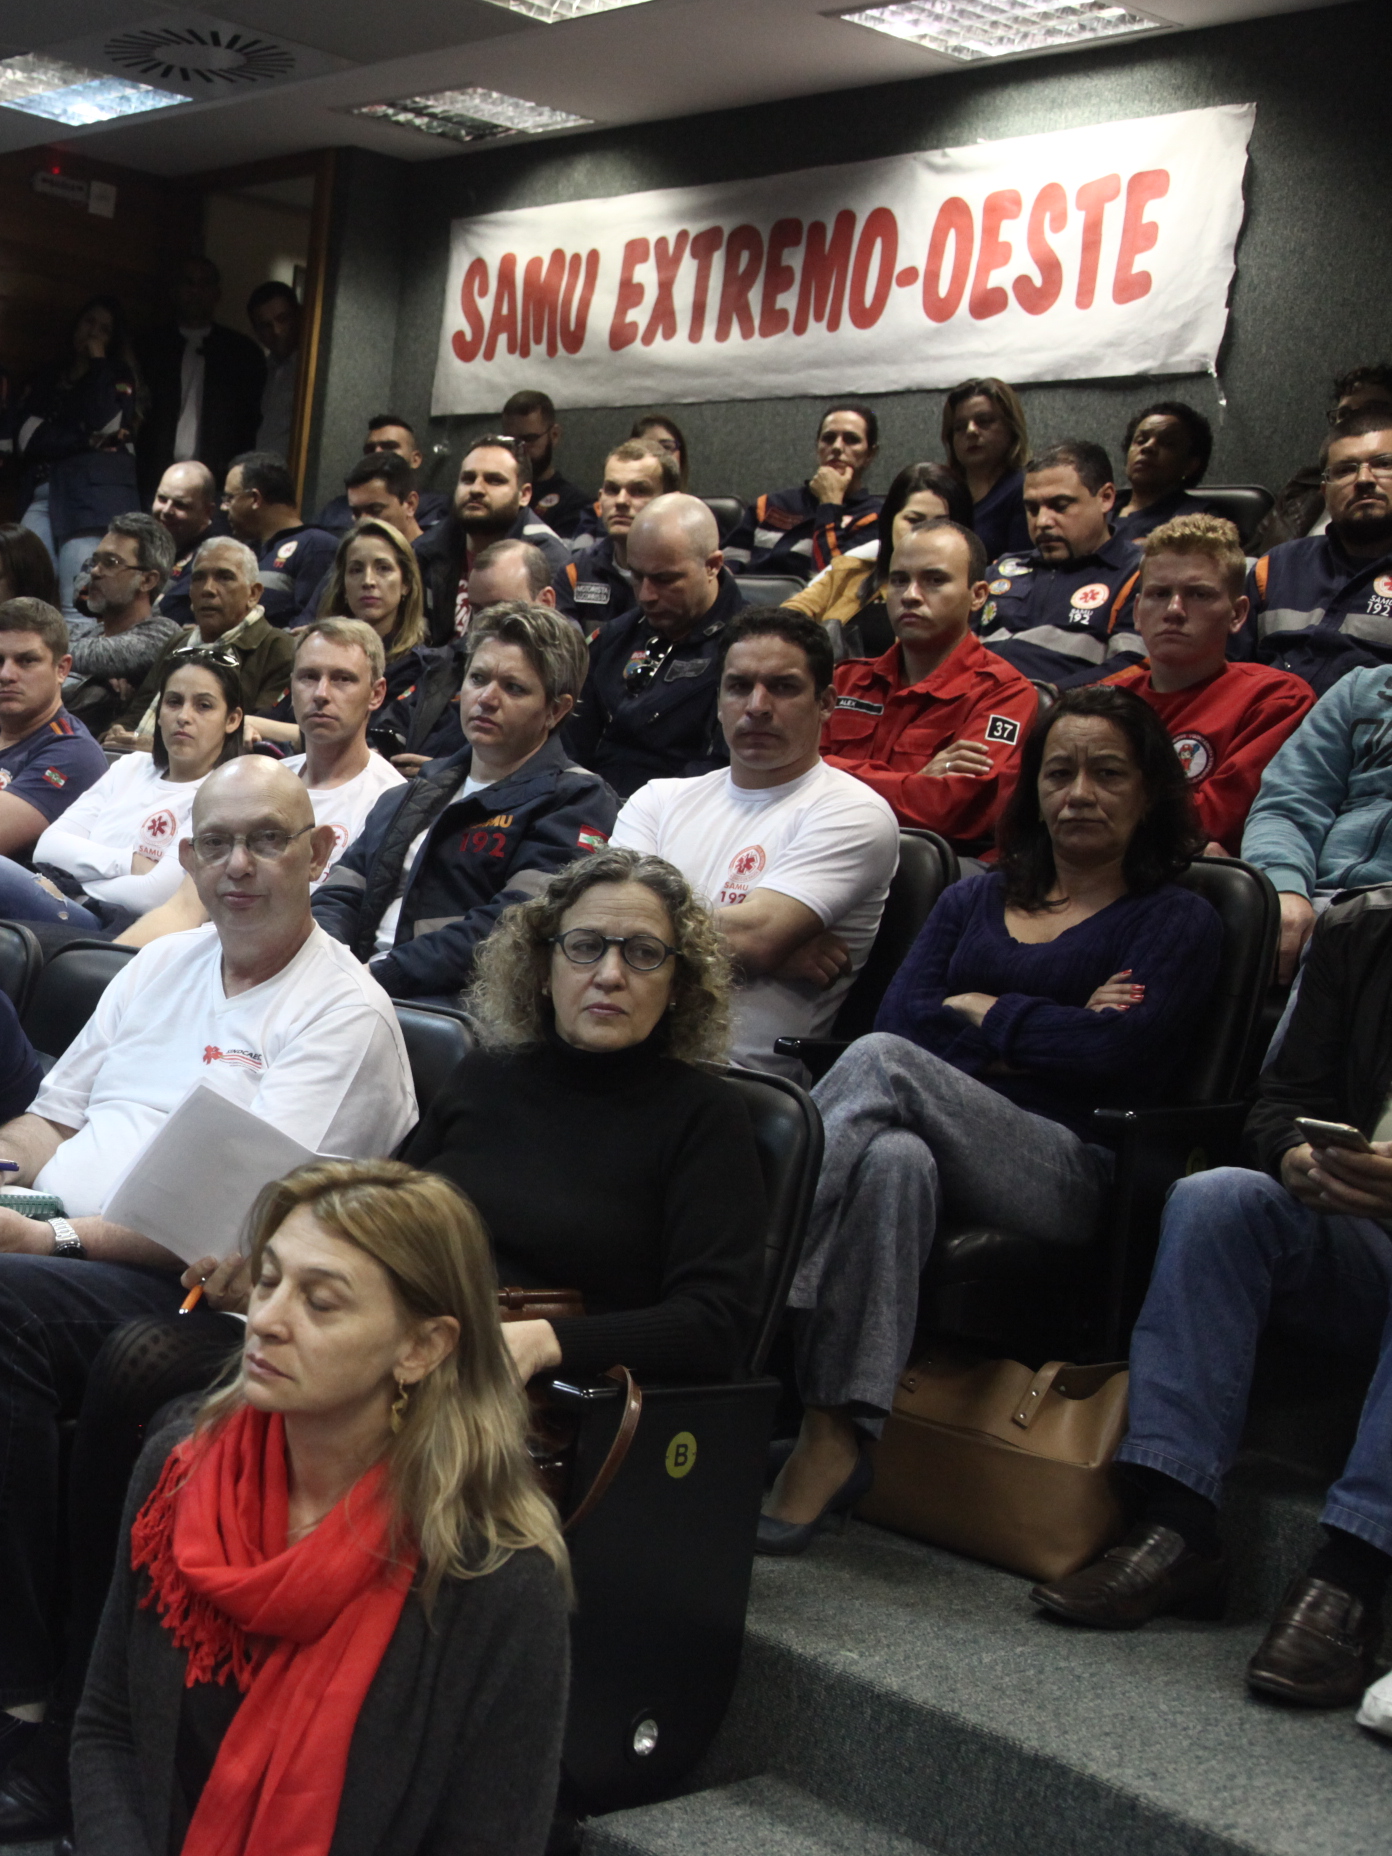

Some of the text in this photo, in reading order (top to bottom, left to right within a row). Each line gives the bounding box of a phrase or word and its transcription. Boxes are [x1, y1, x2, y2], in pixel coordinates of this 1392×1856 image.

[451, 168, 1171, 363] SAMU EXTREMO-OESTE
[1367, 601, 1390, 617] 192
[1069, 612, 1090, 625] 192
[839, 699, 857, 707] ALEX
[993, 721, 1014, 738] 37
[138, 845, 163, 857] SAMU
[459, 832, 506, 857] 192
[724, 881, 749, 891] SAMU
[674, 1443, 689, 1468] B
